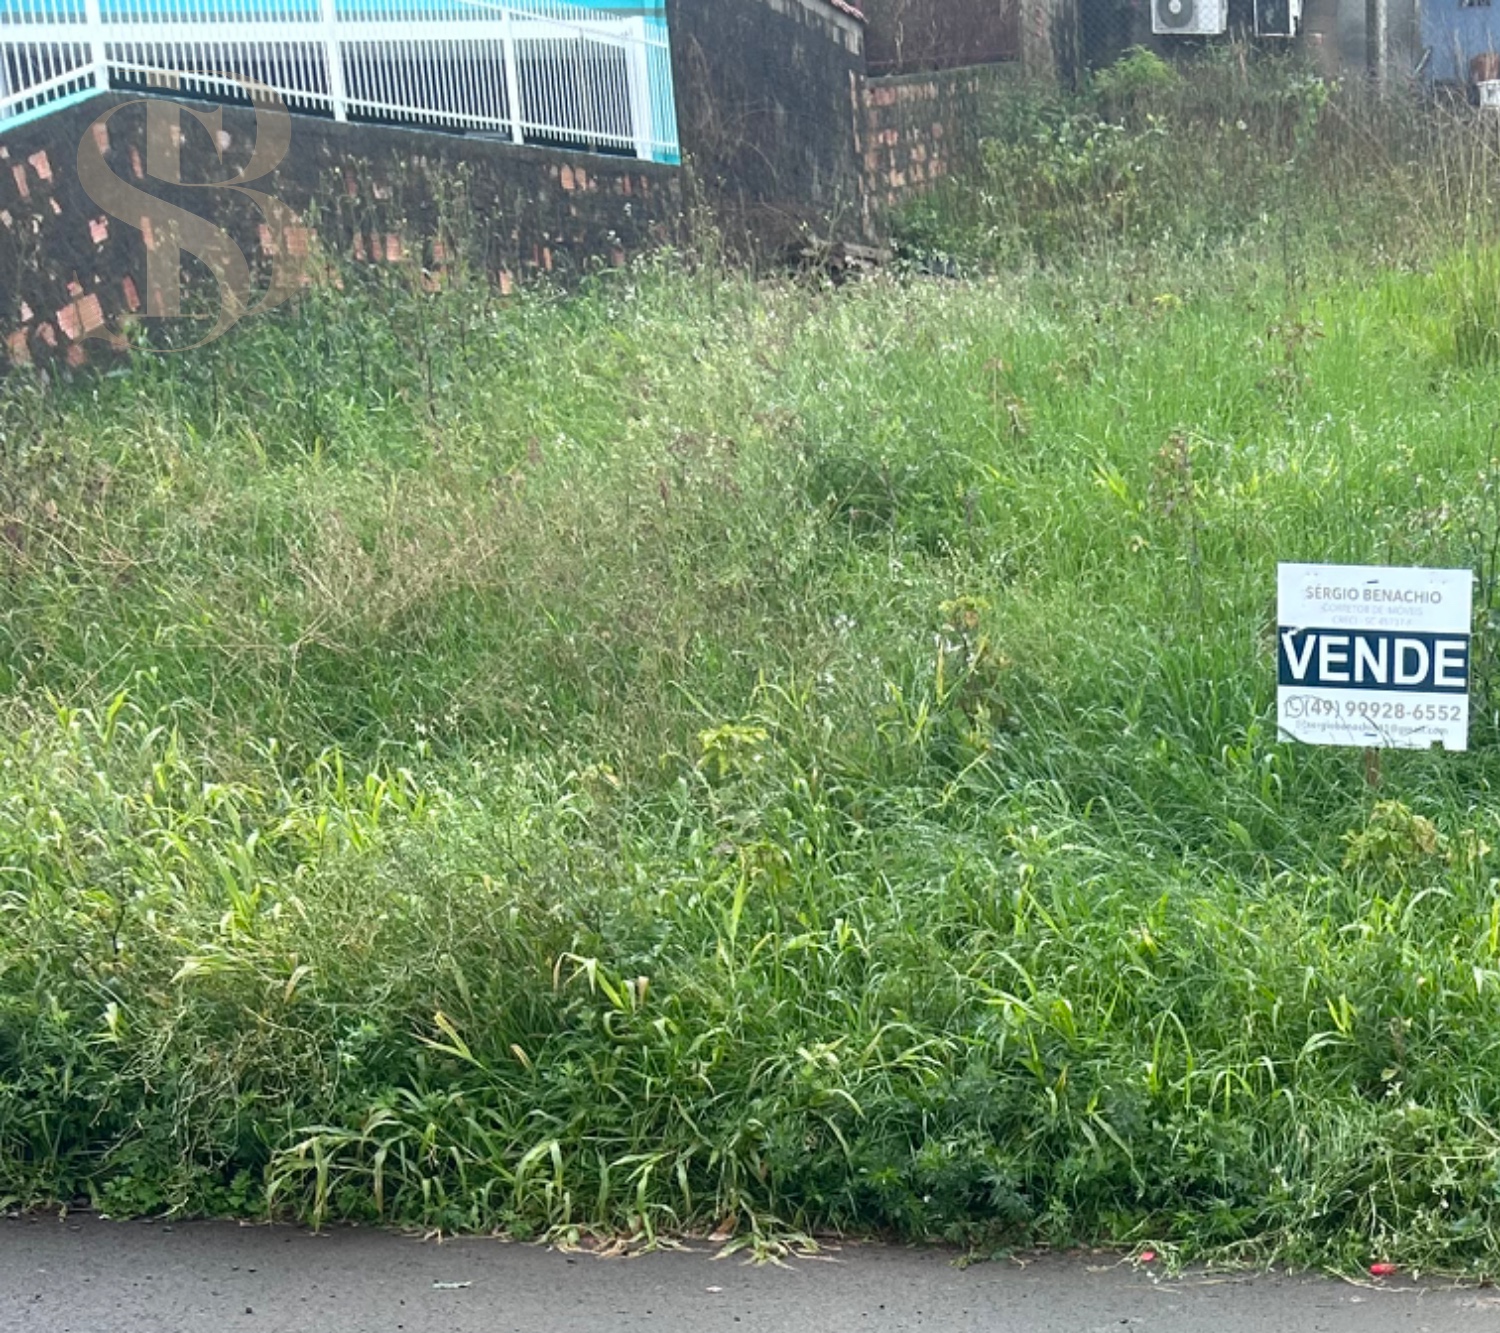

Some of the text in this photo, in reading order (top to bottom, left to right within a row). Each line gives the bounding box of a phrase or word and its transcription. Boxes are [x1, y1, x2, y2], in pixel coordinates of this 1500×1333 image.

[1362, 588, 1442, 605] BENACHIO
[1281, 632, 1467, 687] VENDE
[1304, 699, 1462, 722] (49) 99928-6552
